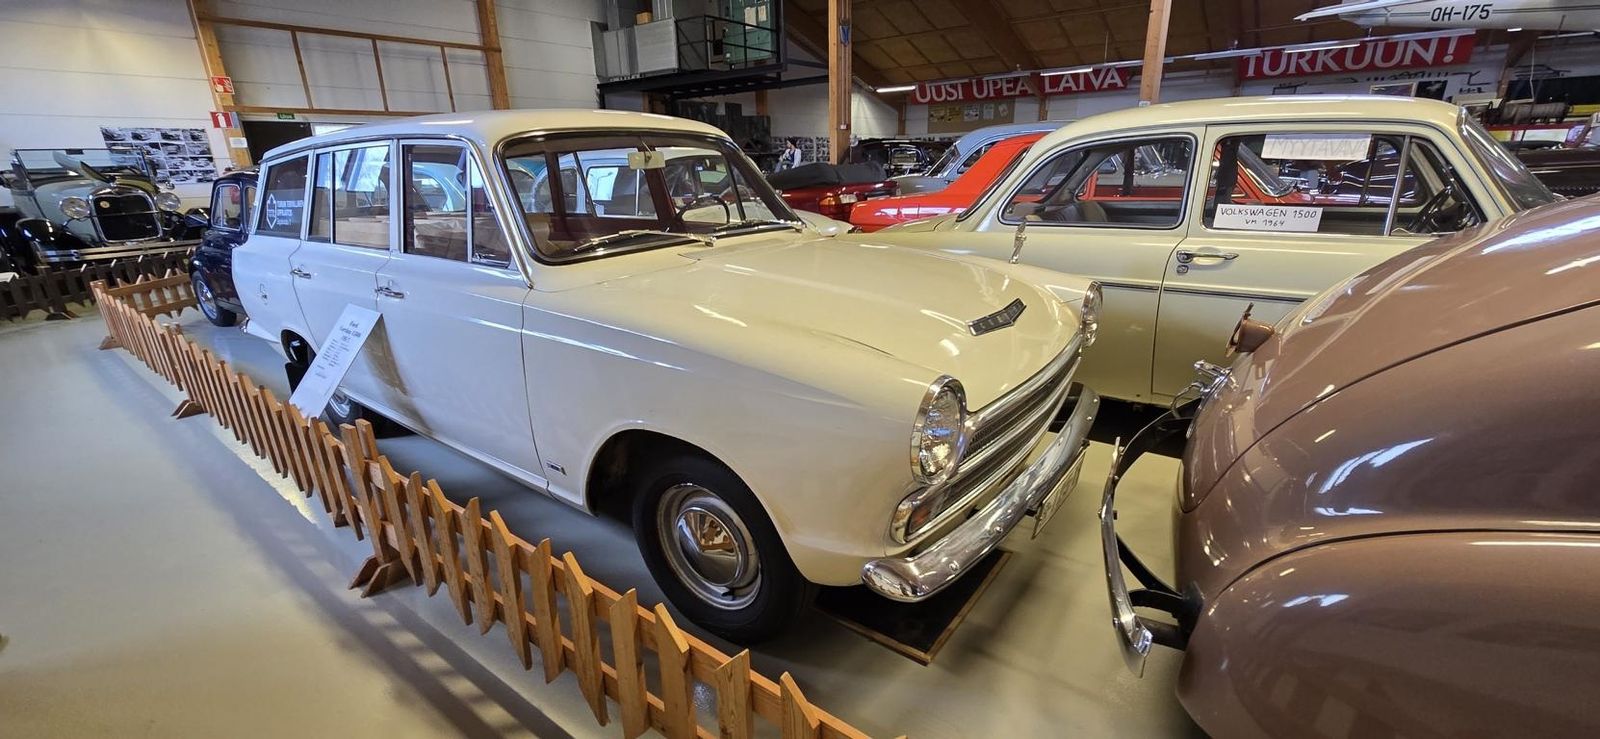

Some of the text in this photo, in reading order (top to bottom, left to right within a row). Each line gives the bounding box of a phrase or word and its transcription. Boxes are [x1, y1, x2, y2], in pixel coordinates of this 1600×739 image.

[1431, 4, 1493, 21] OH-175
[914, 35, 1460, 103] UUSI UPEA LAIVA TURKUUN!
[1220, 207, 1317, 218] VOLKSWAGEN 1500
